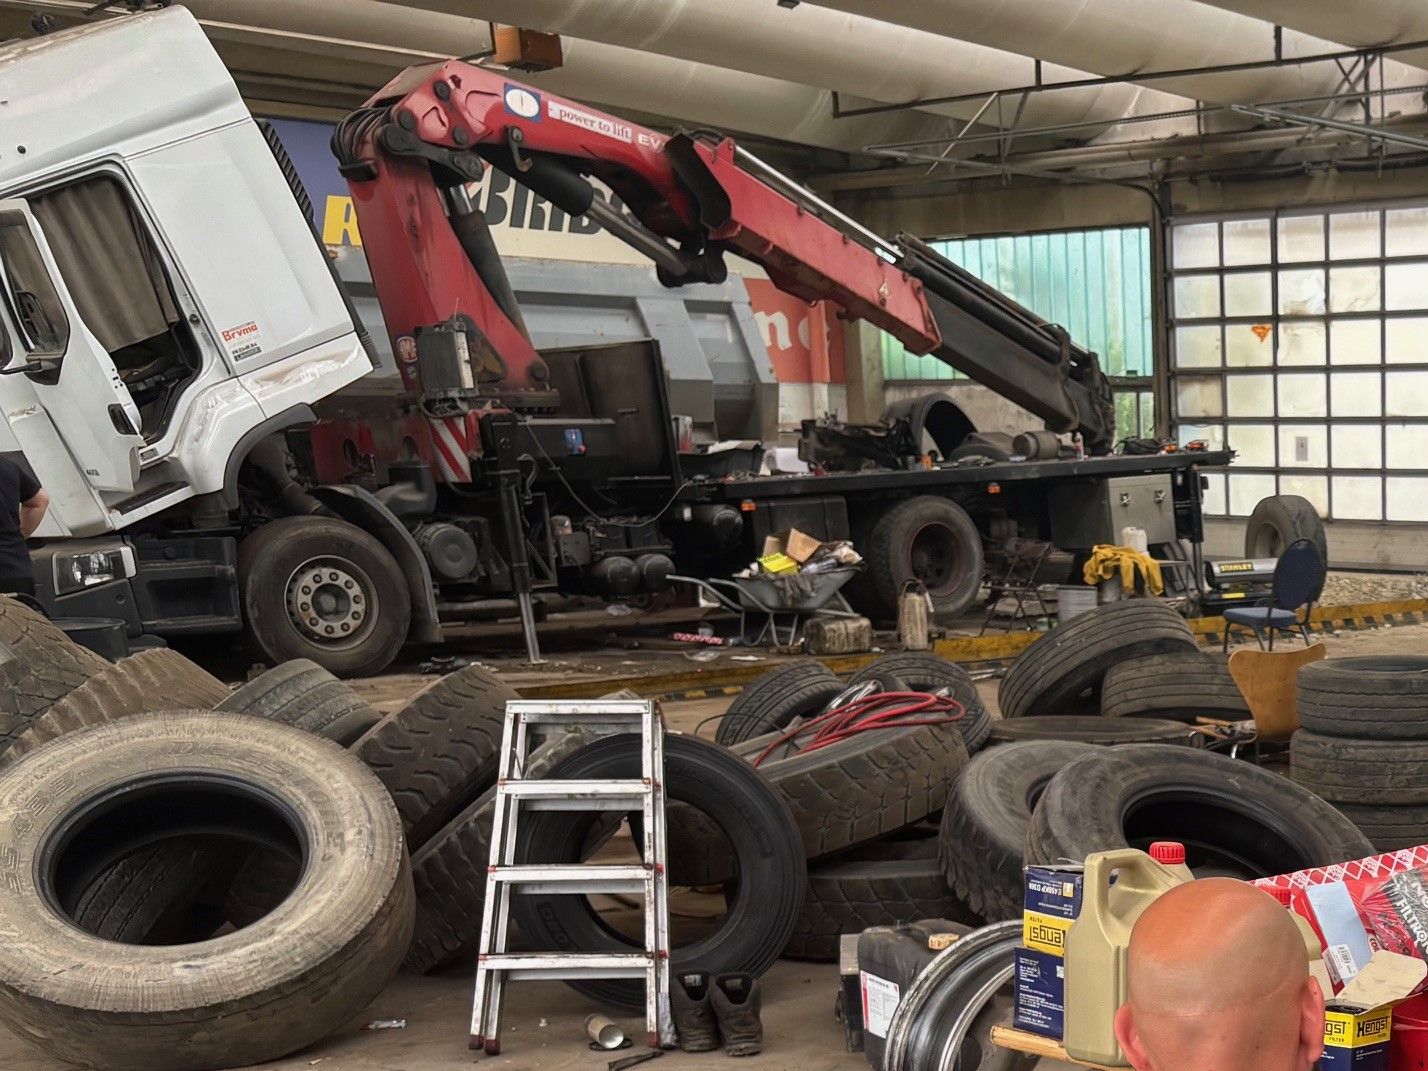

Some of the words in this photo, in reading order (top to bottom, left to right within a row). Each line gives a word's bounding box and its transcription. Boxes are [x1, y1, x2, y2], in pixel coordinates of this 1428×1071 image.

[559, 108, 597, 127] power
[598, 122, 610, 133] to
[612, 122, 632, 139] lift
[1029, 924, 1066, 948] engst
[1357, 1017, 1388, 1037] Hengst
